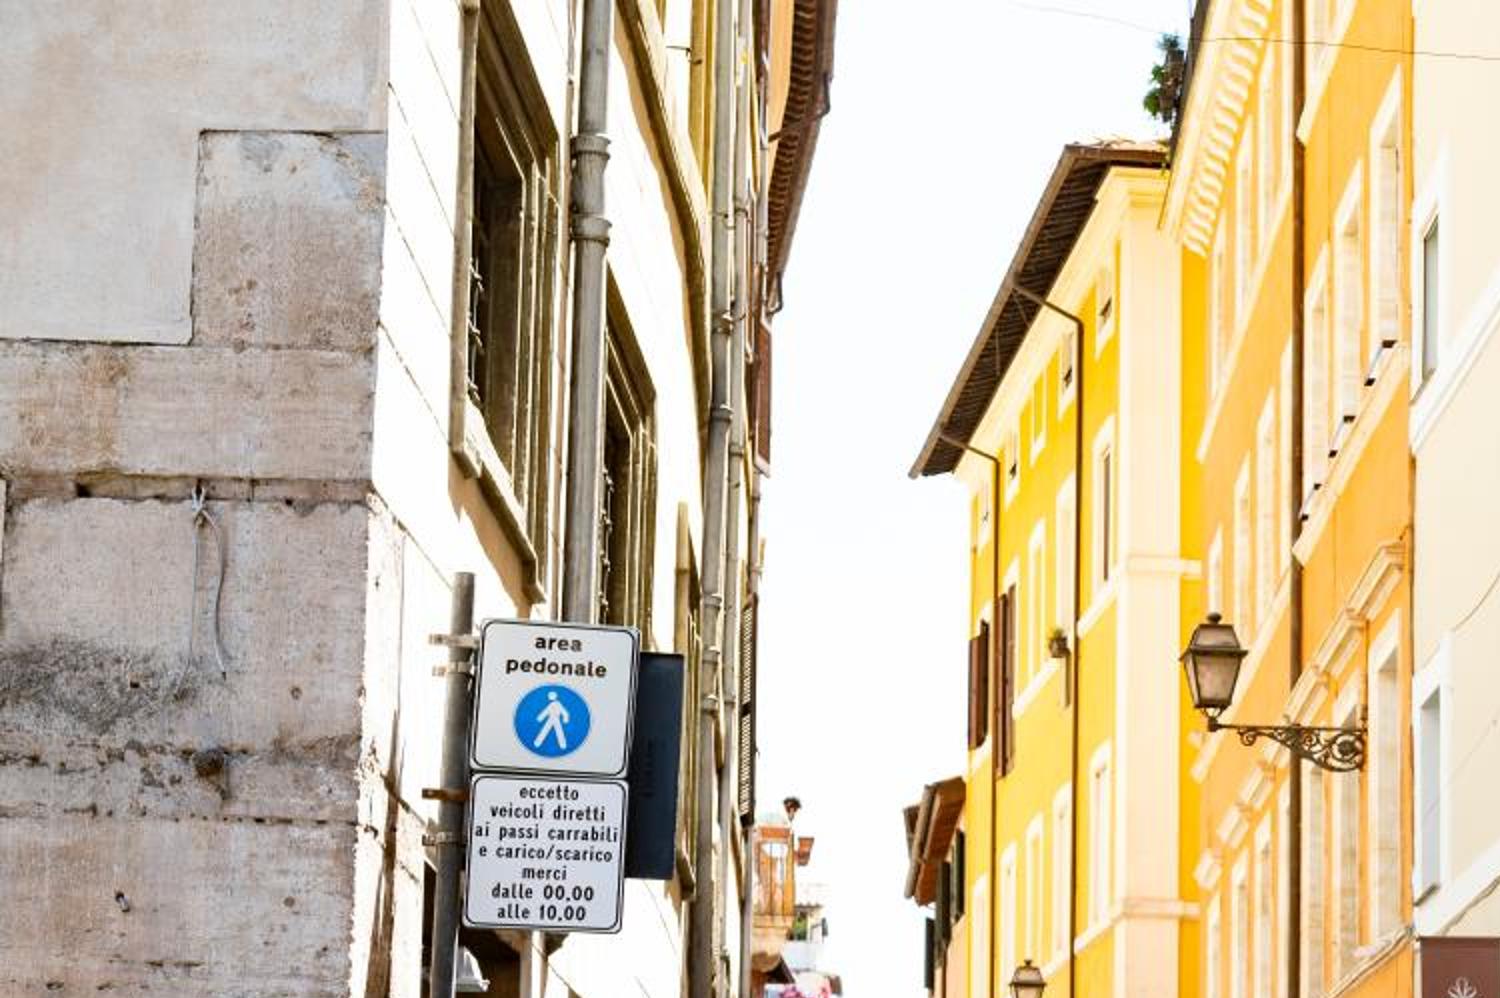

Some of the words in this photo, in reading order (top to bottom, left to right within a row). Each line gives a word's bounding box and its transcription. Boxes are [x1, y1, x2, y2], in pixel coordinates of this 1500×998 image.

[535, 636, 582, 652] area
[506, 657, 607, 678] pedonale
[519, 784, 579, 801] eccetto
[490, 803, 544, 820] veicoli
[553, 805, 606, 822] diretti
[475, 822, 490, 837] ai
[499, 824, 539, 842] passi
[547, 824, 618, 843] carrabili
[479, 845, 488, 856] e
[495, 843, 613, 863] carico/scarico
[522, 864, 567, 881] merci
[491, 883, 533, 900] dalle
[497, 903, 530, 920] alle
